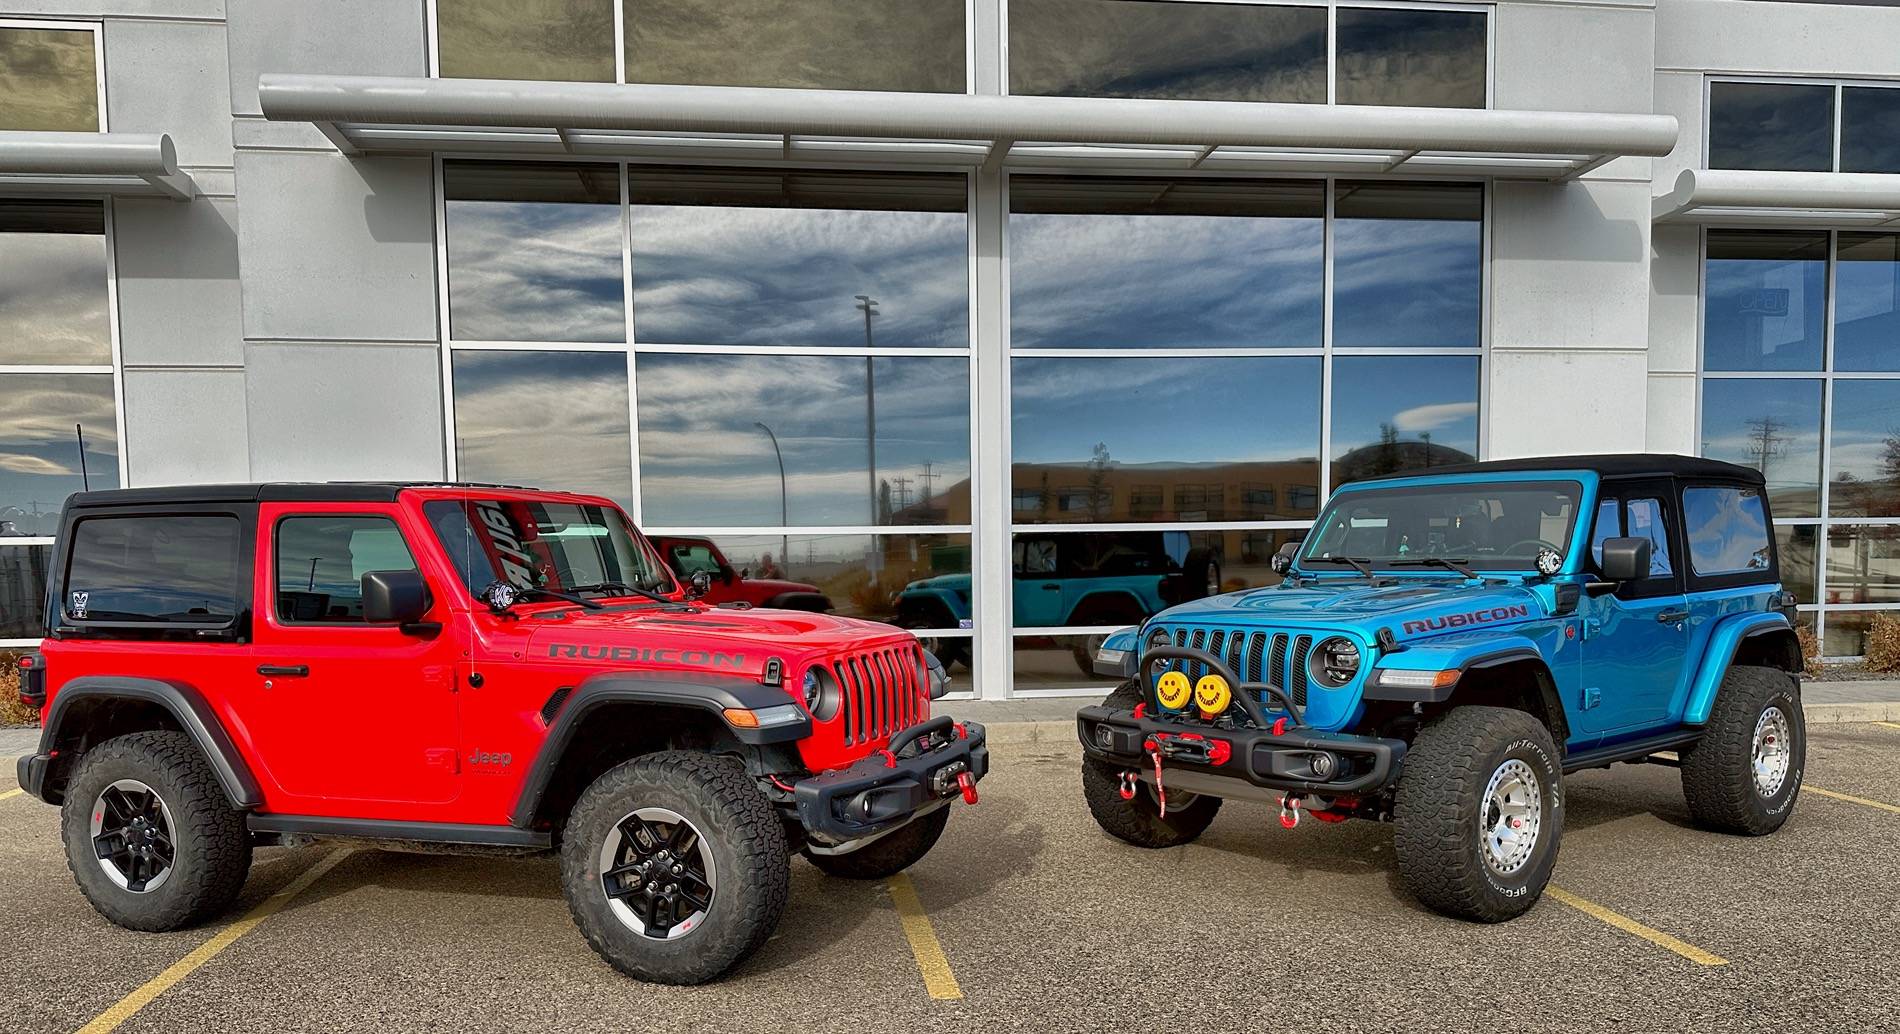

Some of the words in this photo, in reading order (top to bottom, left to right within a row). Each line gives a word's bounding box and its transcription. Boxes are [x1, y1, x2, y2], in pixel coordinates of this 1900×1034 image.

[1403, 604, 1528, 635] RUBICON
[549, 643, 745, 669] RUBICON
[469, 747, 513, 768] Jeep
[1505, 739, 1554, 775] All-Terrain
[1551, 782, 1560, 808] T/A
